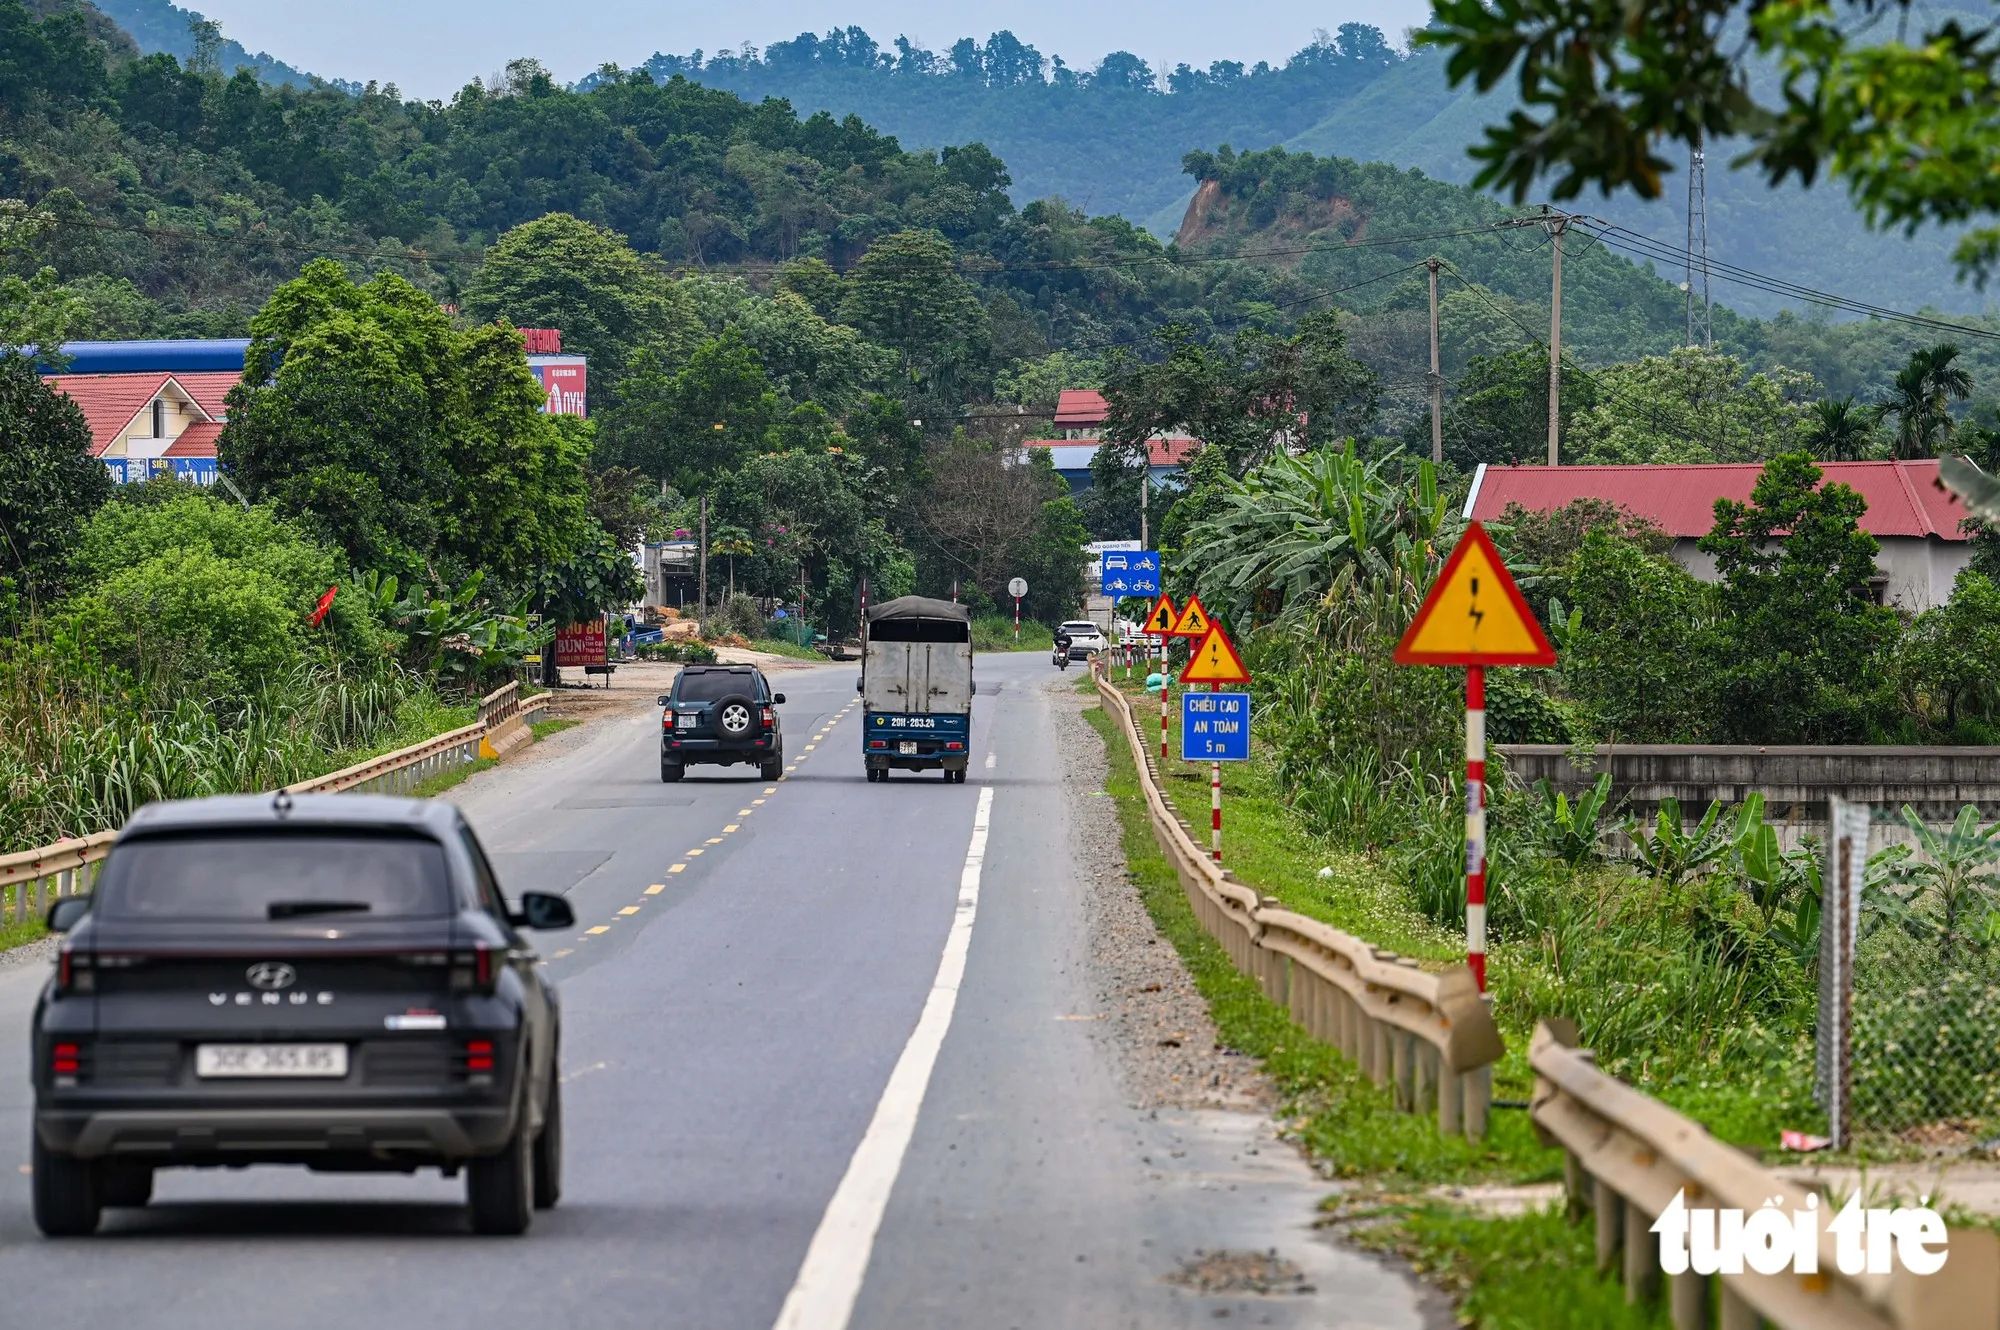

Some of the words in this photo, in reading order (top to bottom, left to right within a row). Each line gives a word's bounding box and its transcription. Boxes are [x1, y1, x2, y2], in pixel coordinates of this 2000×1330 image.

[557, 635, 582, 653] BÚN
[1220, 700, 1239, 713] CAO
[1193, 720, 1208, 733] AN
[1213, 717, 1239, 733] TOÀN
[1206, 739, 1213, 753] 5
[1215, 743, 1226, 753] m
[208, 991, 335, 1006] VENUE
